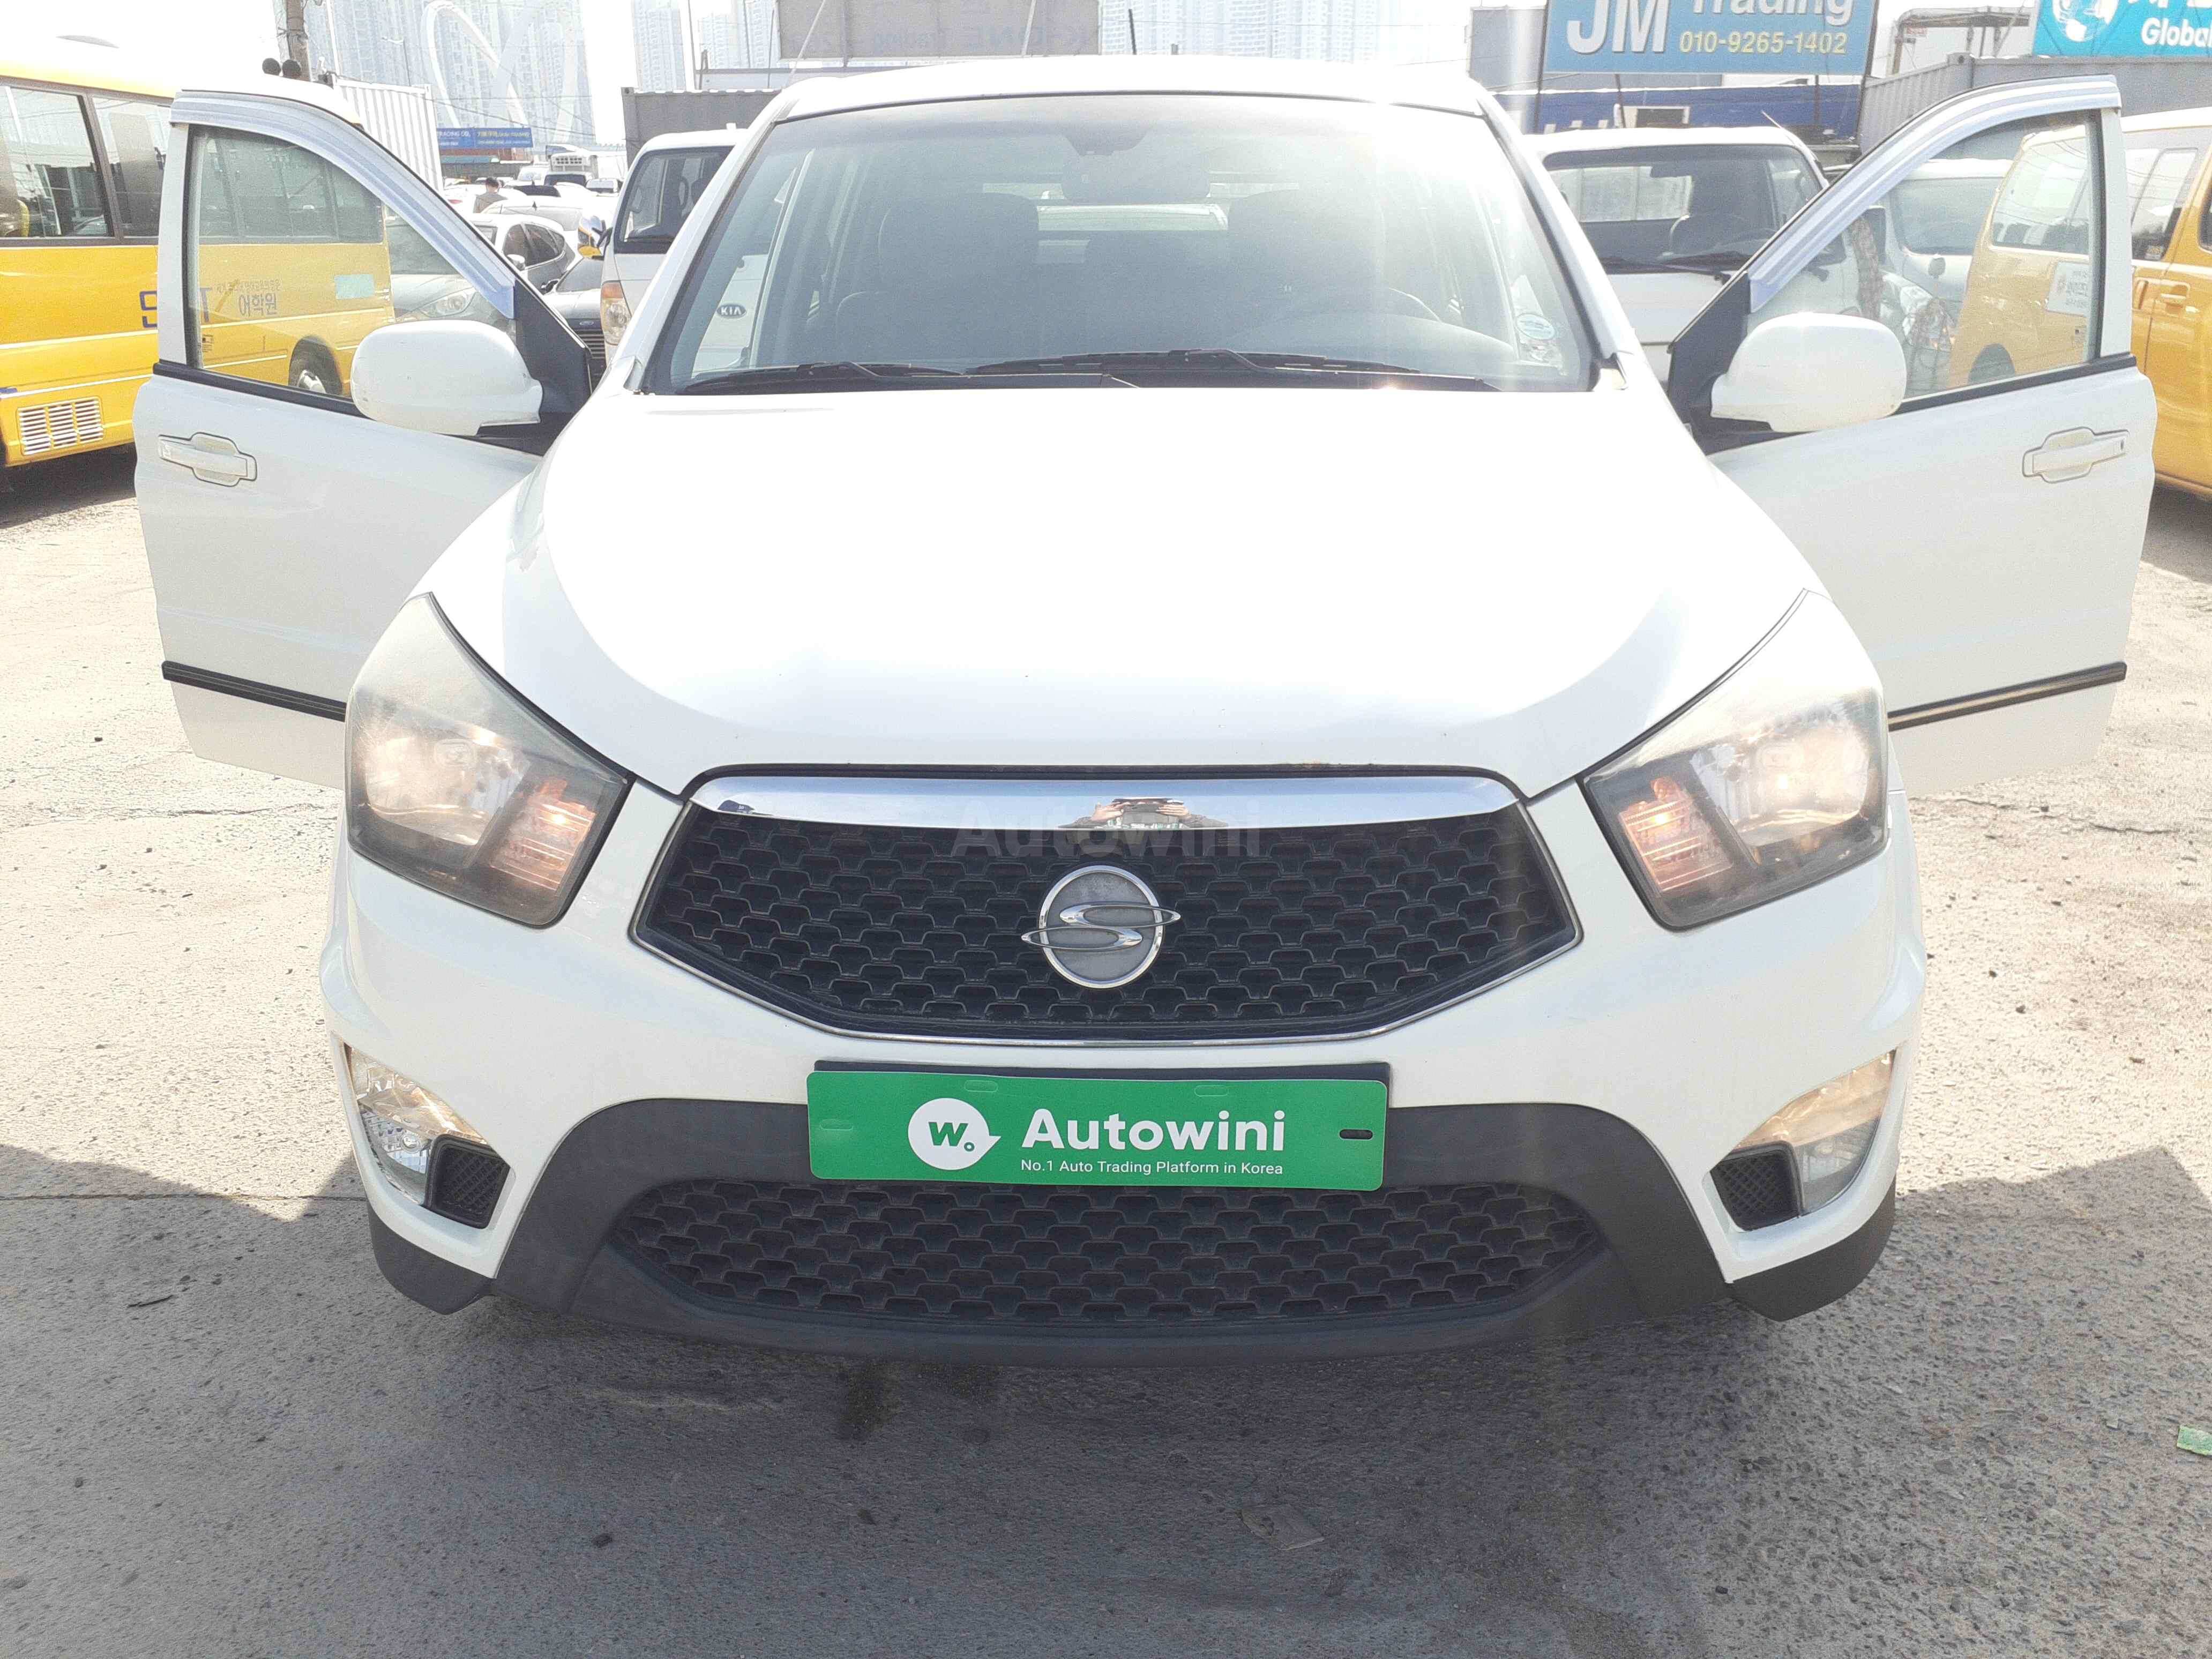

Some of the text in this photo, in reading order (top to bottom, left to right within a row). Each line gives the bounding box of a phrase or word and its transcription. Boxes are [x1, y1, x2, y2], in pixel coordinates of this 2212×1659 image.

[1566, 0, 1669, 54] JM
[2141, 17, 2212, 47] Globa
[1679, 31, 1849, 54] 010-9265-1402
[238, 293, 277, 317] 어학원
[721, 306, 742, 316] KIA
[1021, 1108, 1285, 1150] Autowini
[1021, 1159, 1283, 1176] No.1 Auto Trading Platform in Korea
